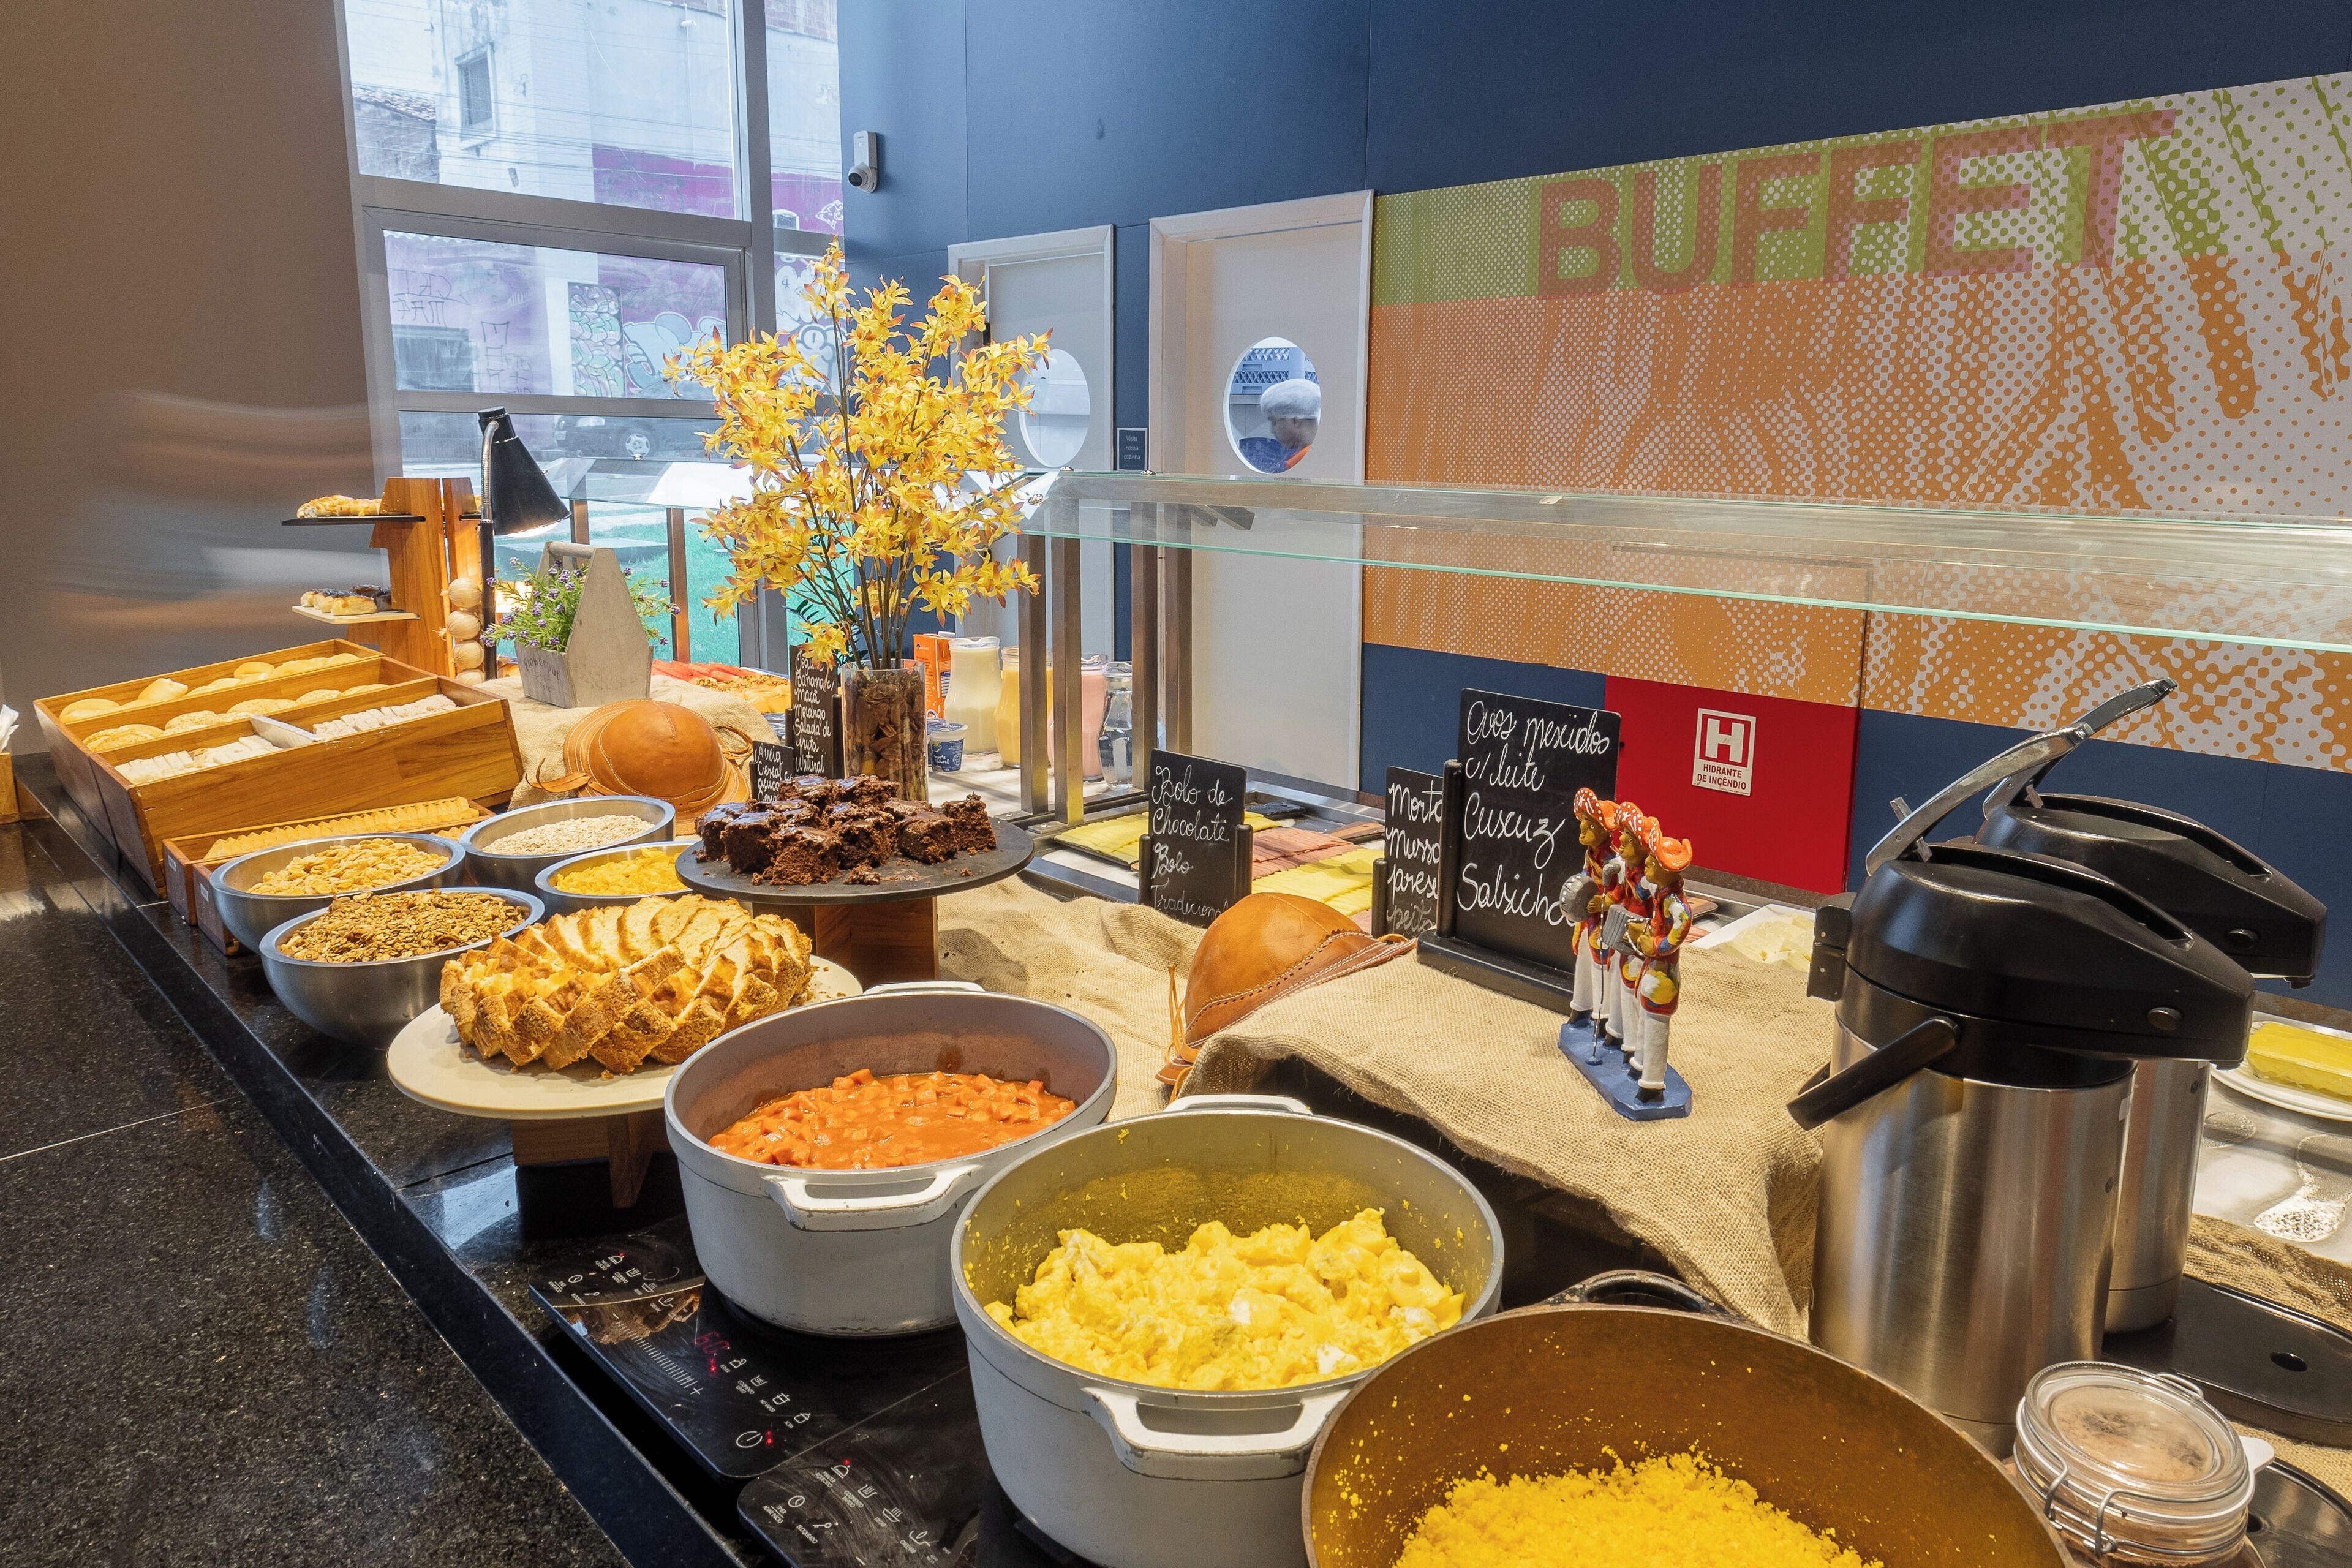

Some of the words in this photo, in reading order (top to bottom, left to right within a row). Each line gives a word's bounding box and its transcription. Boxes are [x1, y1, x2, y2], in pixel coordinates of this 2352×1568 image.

[1537, 107, 2177, 300] BUFFET
[524, 658, 559, 681] Flowerpot
[1705, 718, 1745, 763] H
[758, 778, 780, 792] açuca
[1152, 764, 1201, 807] Bolo
[1208, 778, 1234, 807] de
[1697, 774, 1707, 783] DE
[1709, 776, 1746, 790] INCÊNDIO
[1703, 764, 1742, 778] HIDRANTE
[1388, 780, 1443, 823] Morta
[1152, 805, 1230, 841] Chocolate
[1385, 827, 1441, 865] Mussa
